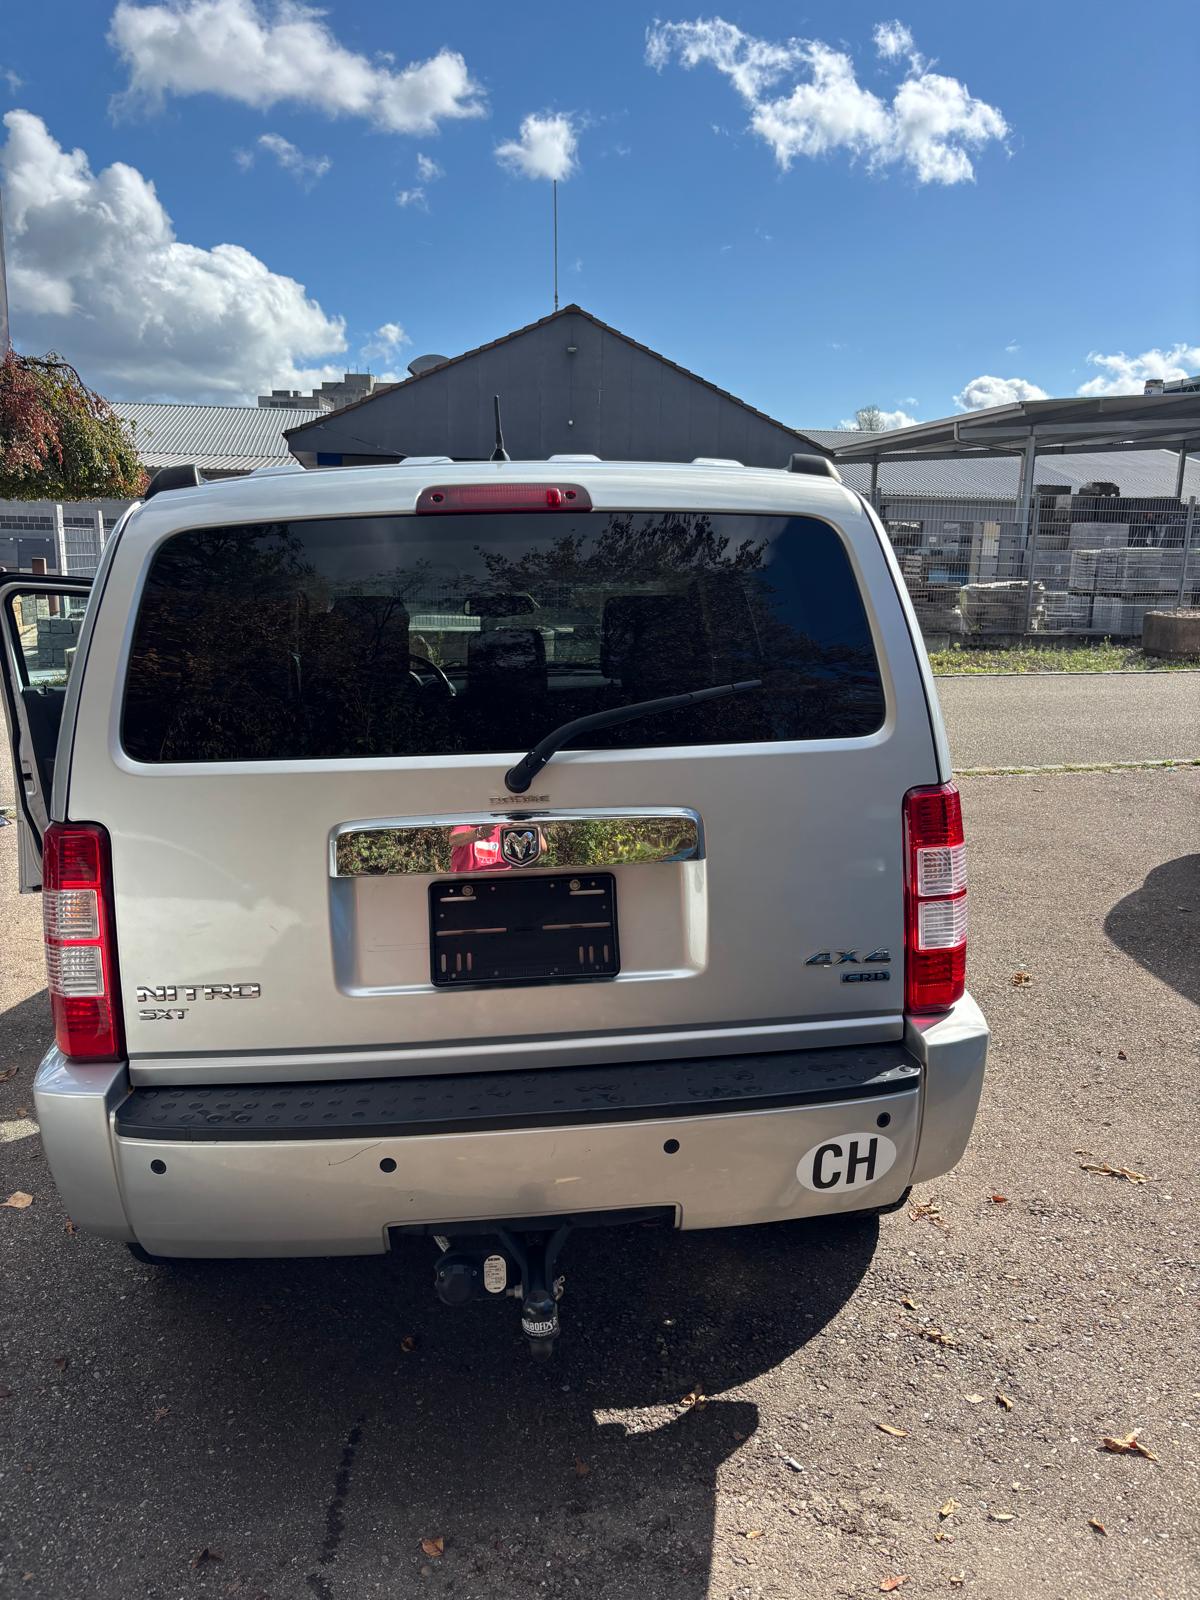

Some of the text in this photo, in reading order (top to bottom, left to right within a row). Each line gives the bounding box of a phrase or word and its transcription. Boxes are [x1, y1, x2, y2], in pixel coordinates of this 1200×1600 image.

[136, 983, 261, 1002] NITRO
[138, 1008, 189, 1020] SXT
[812, 1137, 878, 1189] CH
